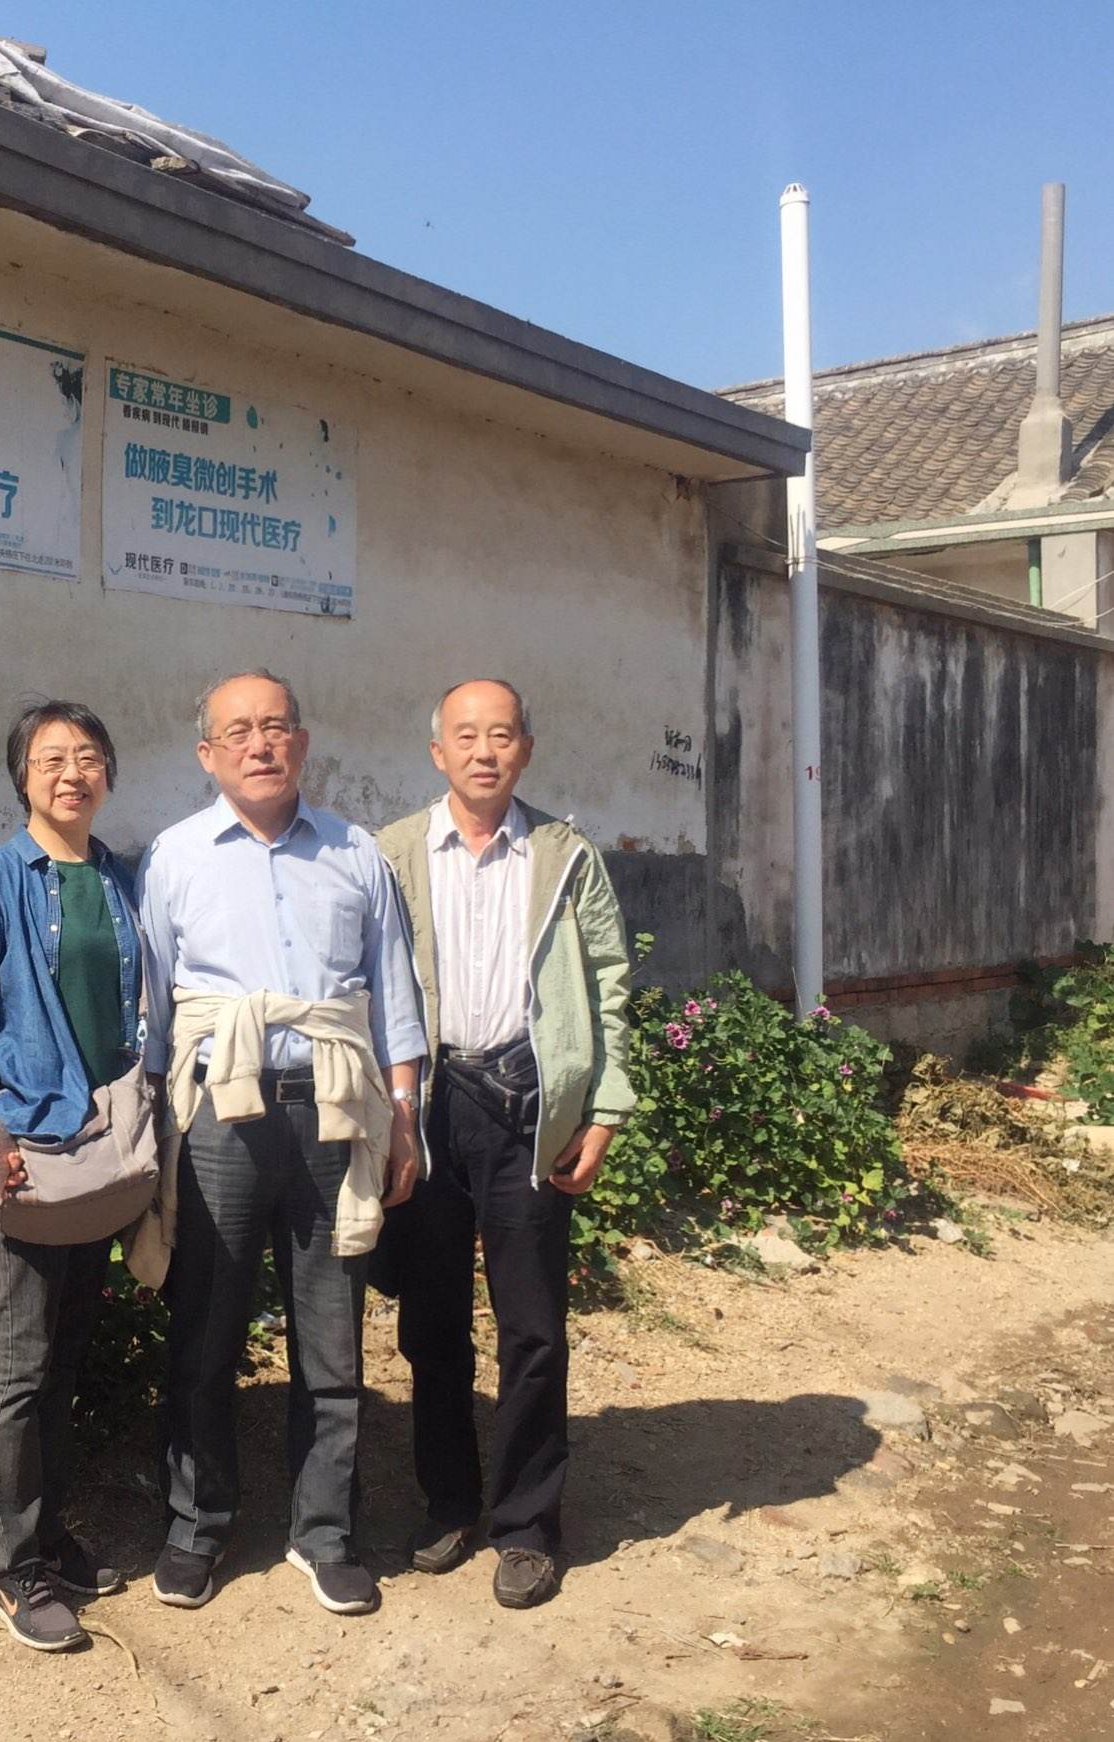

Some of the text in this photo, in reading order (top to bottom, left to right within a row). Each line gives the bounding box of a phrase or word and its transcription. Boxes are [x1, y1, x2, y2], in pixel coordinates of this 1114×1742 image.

[115, 372, 219, 419] 专家常年坐诊
[124, 442, 279, 504] 做腋臭微创手术
[151, 496, 302, 553] 到龙口现代医疗
[124, 551, 175, 576] 现代医疗
